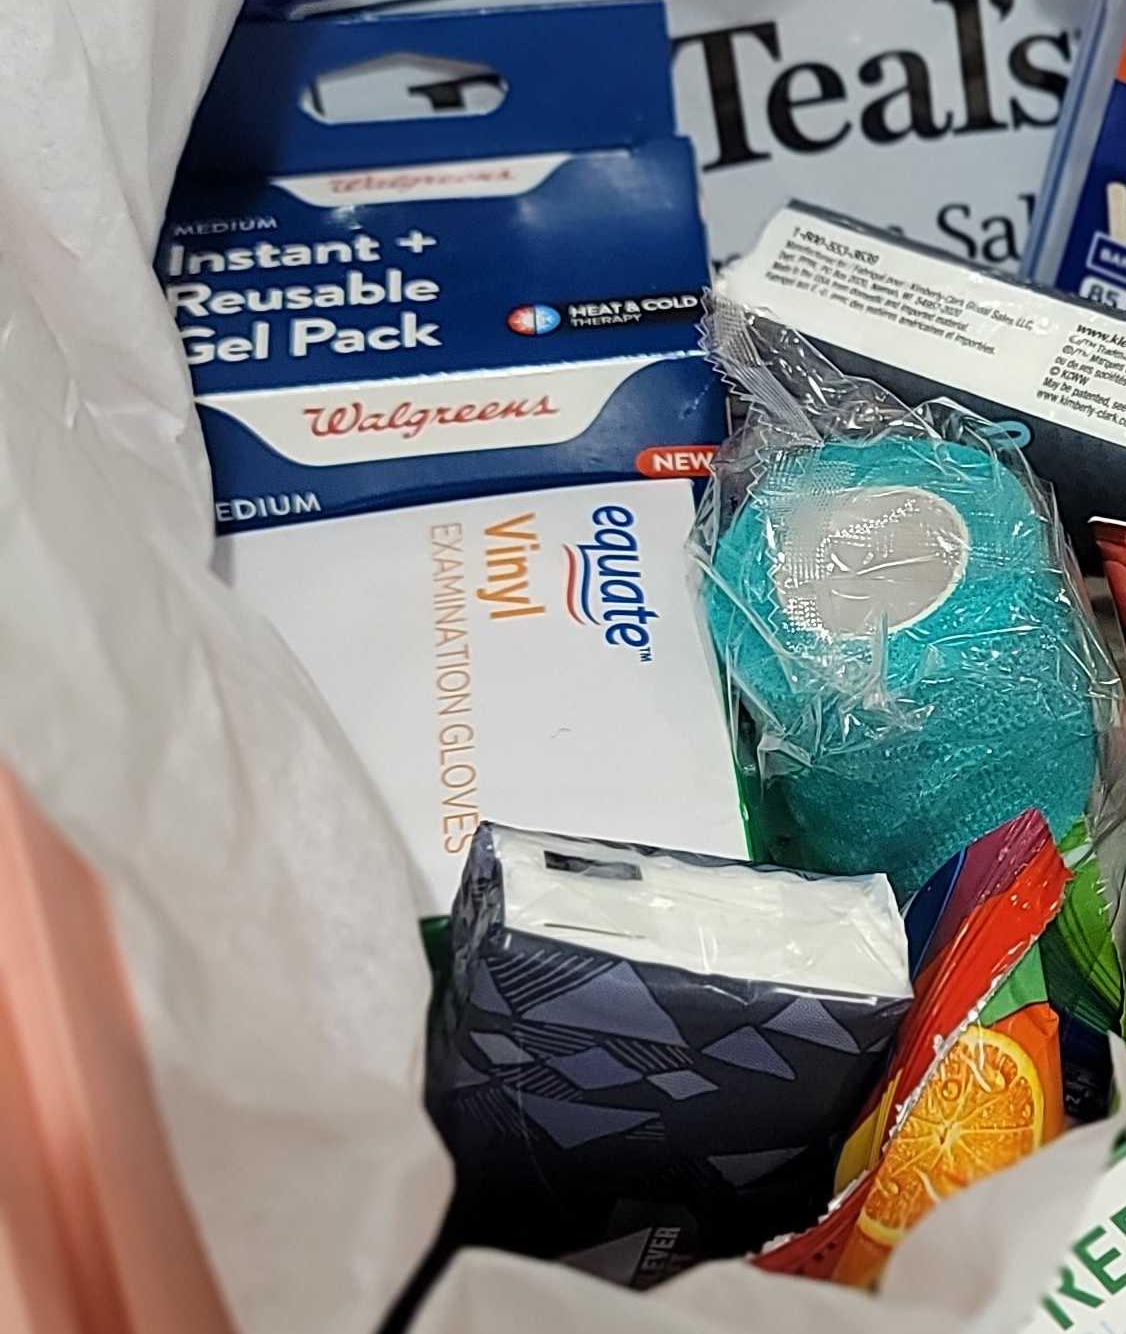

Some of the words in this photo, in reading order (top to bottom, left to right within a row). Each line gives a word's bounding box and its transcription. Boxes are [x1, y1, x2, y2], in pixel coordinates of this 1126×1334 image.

[173, 216, 279, 237] MEDIUM
[168, 231, 380, 278] Instant
[166, 270, 440, 319] Reusable
[568, 301, 623, 319] HEAT
[624, 298, 640, 315] &
[640, 294, 699, 312] COLD
[178, 322, 269, 367] Gel
[290, 311, 443, 359] Pack
[570, 312, 643, 328] THERAPY
[303, 392, 560, 440] Walgreens
[653, 451, 714, 472] NEW
[214, 491, 321, 522] EDIUM
[476, 512, 546, 619] Vinyl
[430, 522, 474, 718] EXAMINATION
[438, 722, 481, 855] GLOVES
